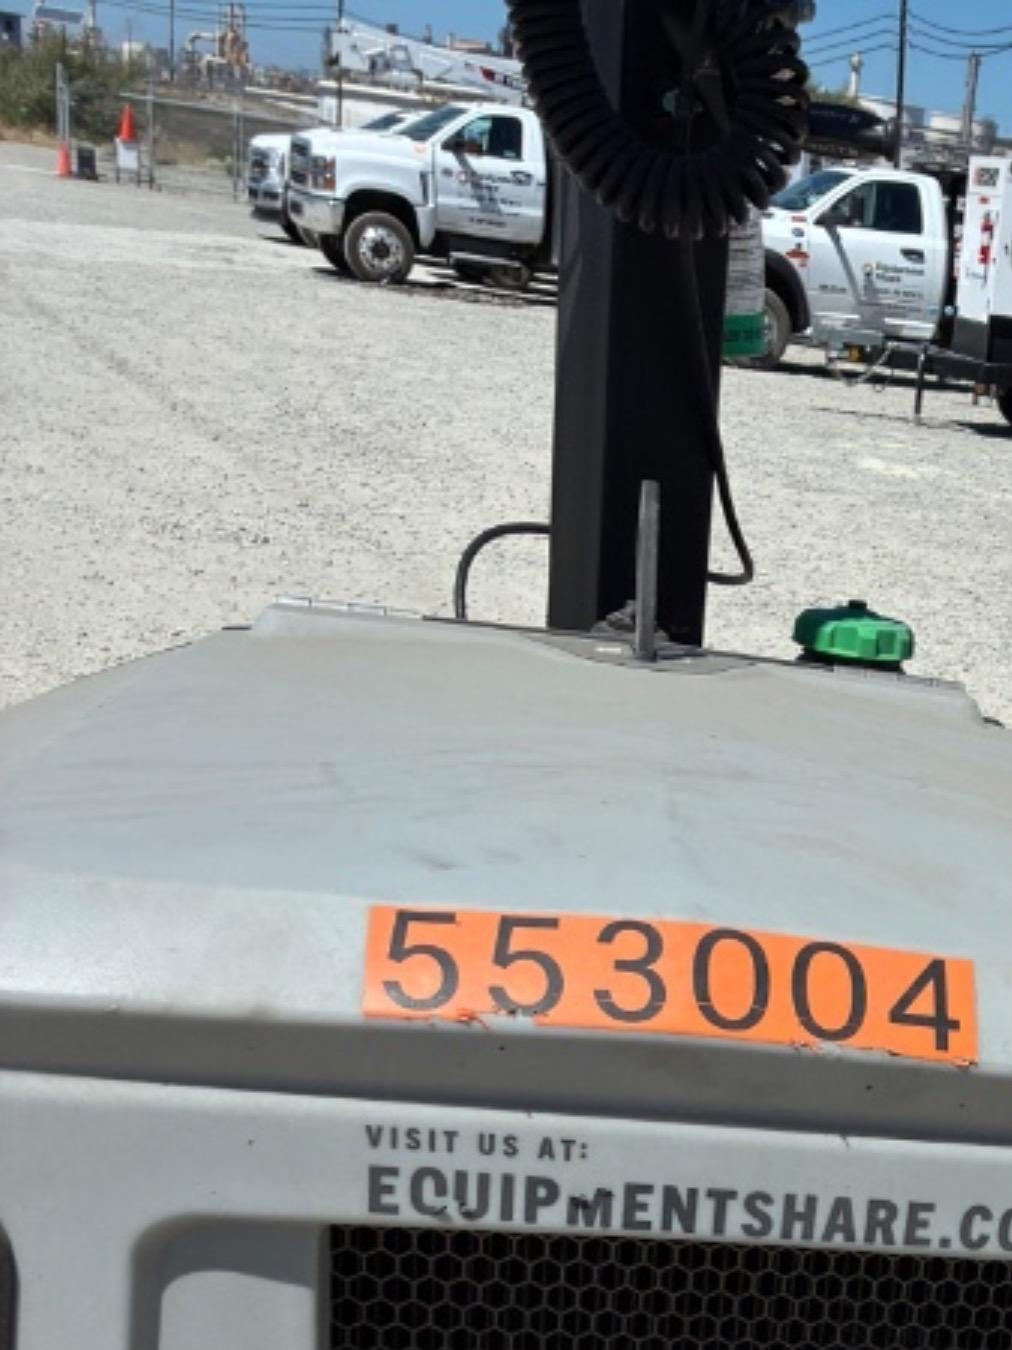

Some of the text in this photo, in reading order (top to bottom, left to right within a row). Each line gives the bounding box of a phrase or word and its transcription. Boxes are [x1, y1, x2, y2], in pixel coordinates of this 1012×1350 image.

[381, 910, 962, 1052] 553004
[365, 1124, 588, 1162] VISIT US AT:
